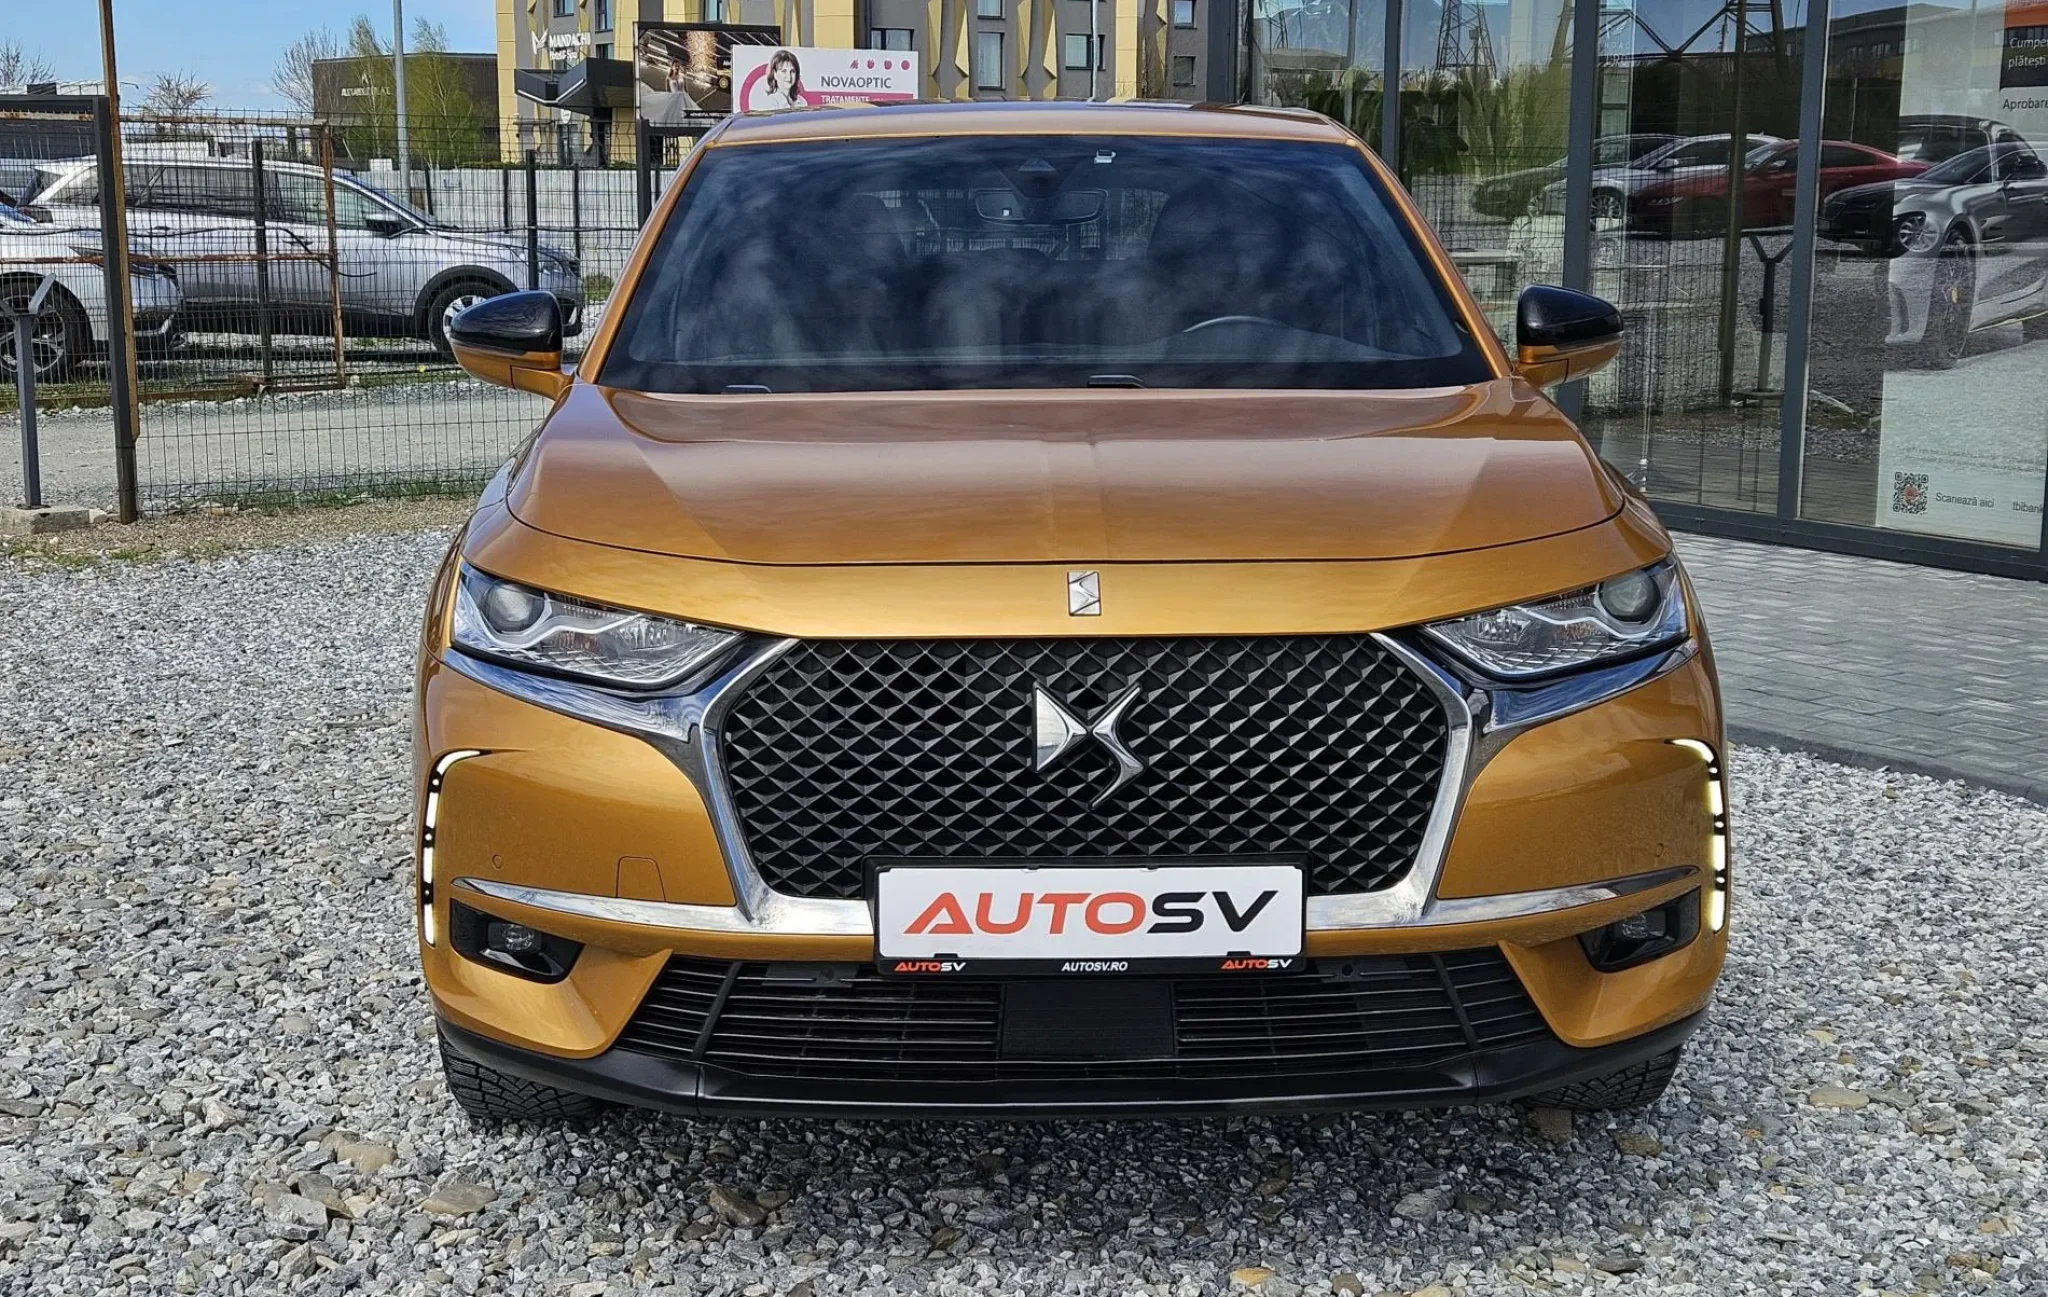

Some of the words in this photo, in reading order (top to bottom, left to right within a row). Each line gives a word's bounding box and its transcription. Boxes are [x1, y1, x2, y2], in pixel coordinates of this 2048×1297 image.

[549, 32, 591, 47] MANDACHI
[821, 75, 892, 89] NOVAOPTIC
[1979, 498, 1995, 508] aici
[904, 890, 1279, 936] AUTOSV
[894, 961, 967, 972] AUTOSV
[1061, 961, 1129, 972] AUTOSV.RO
[1221, 958, 1293, 970] AUTOSV
